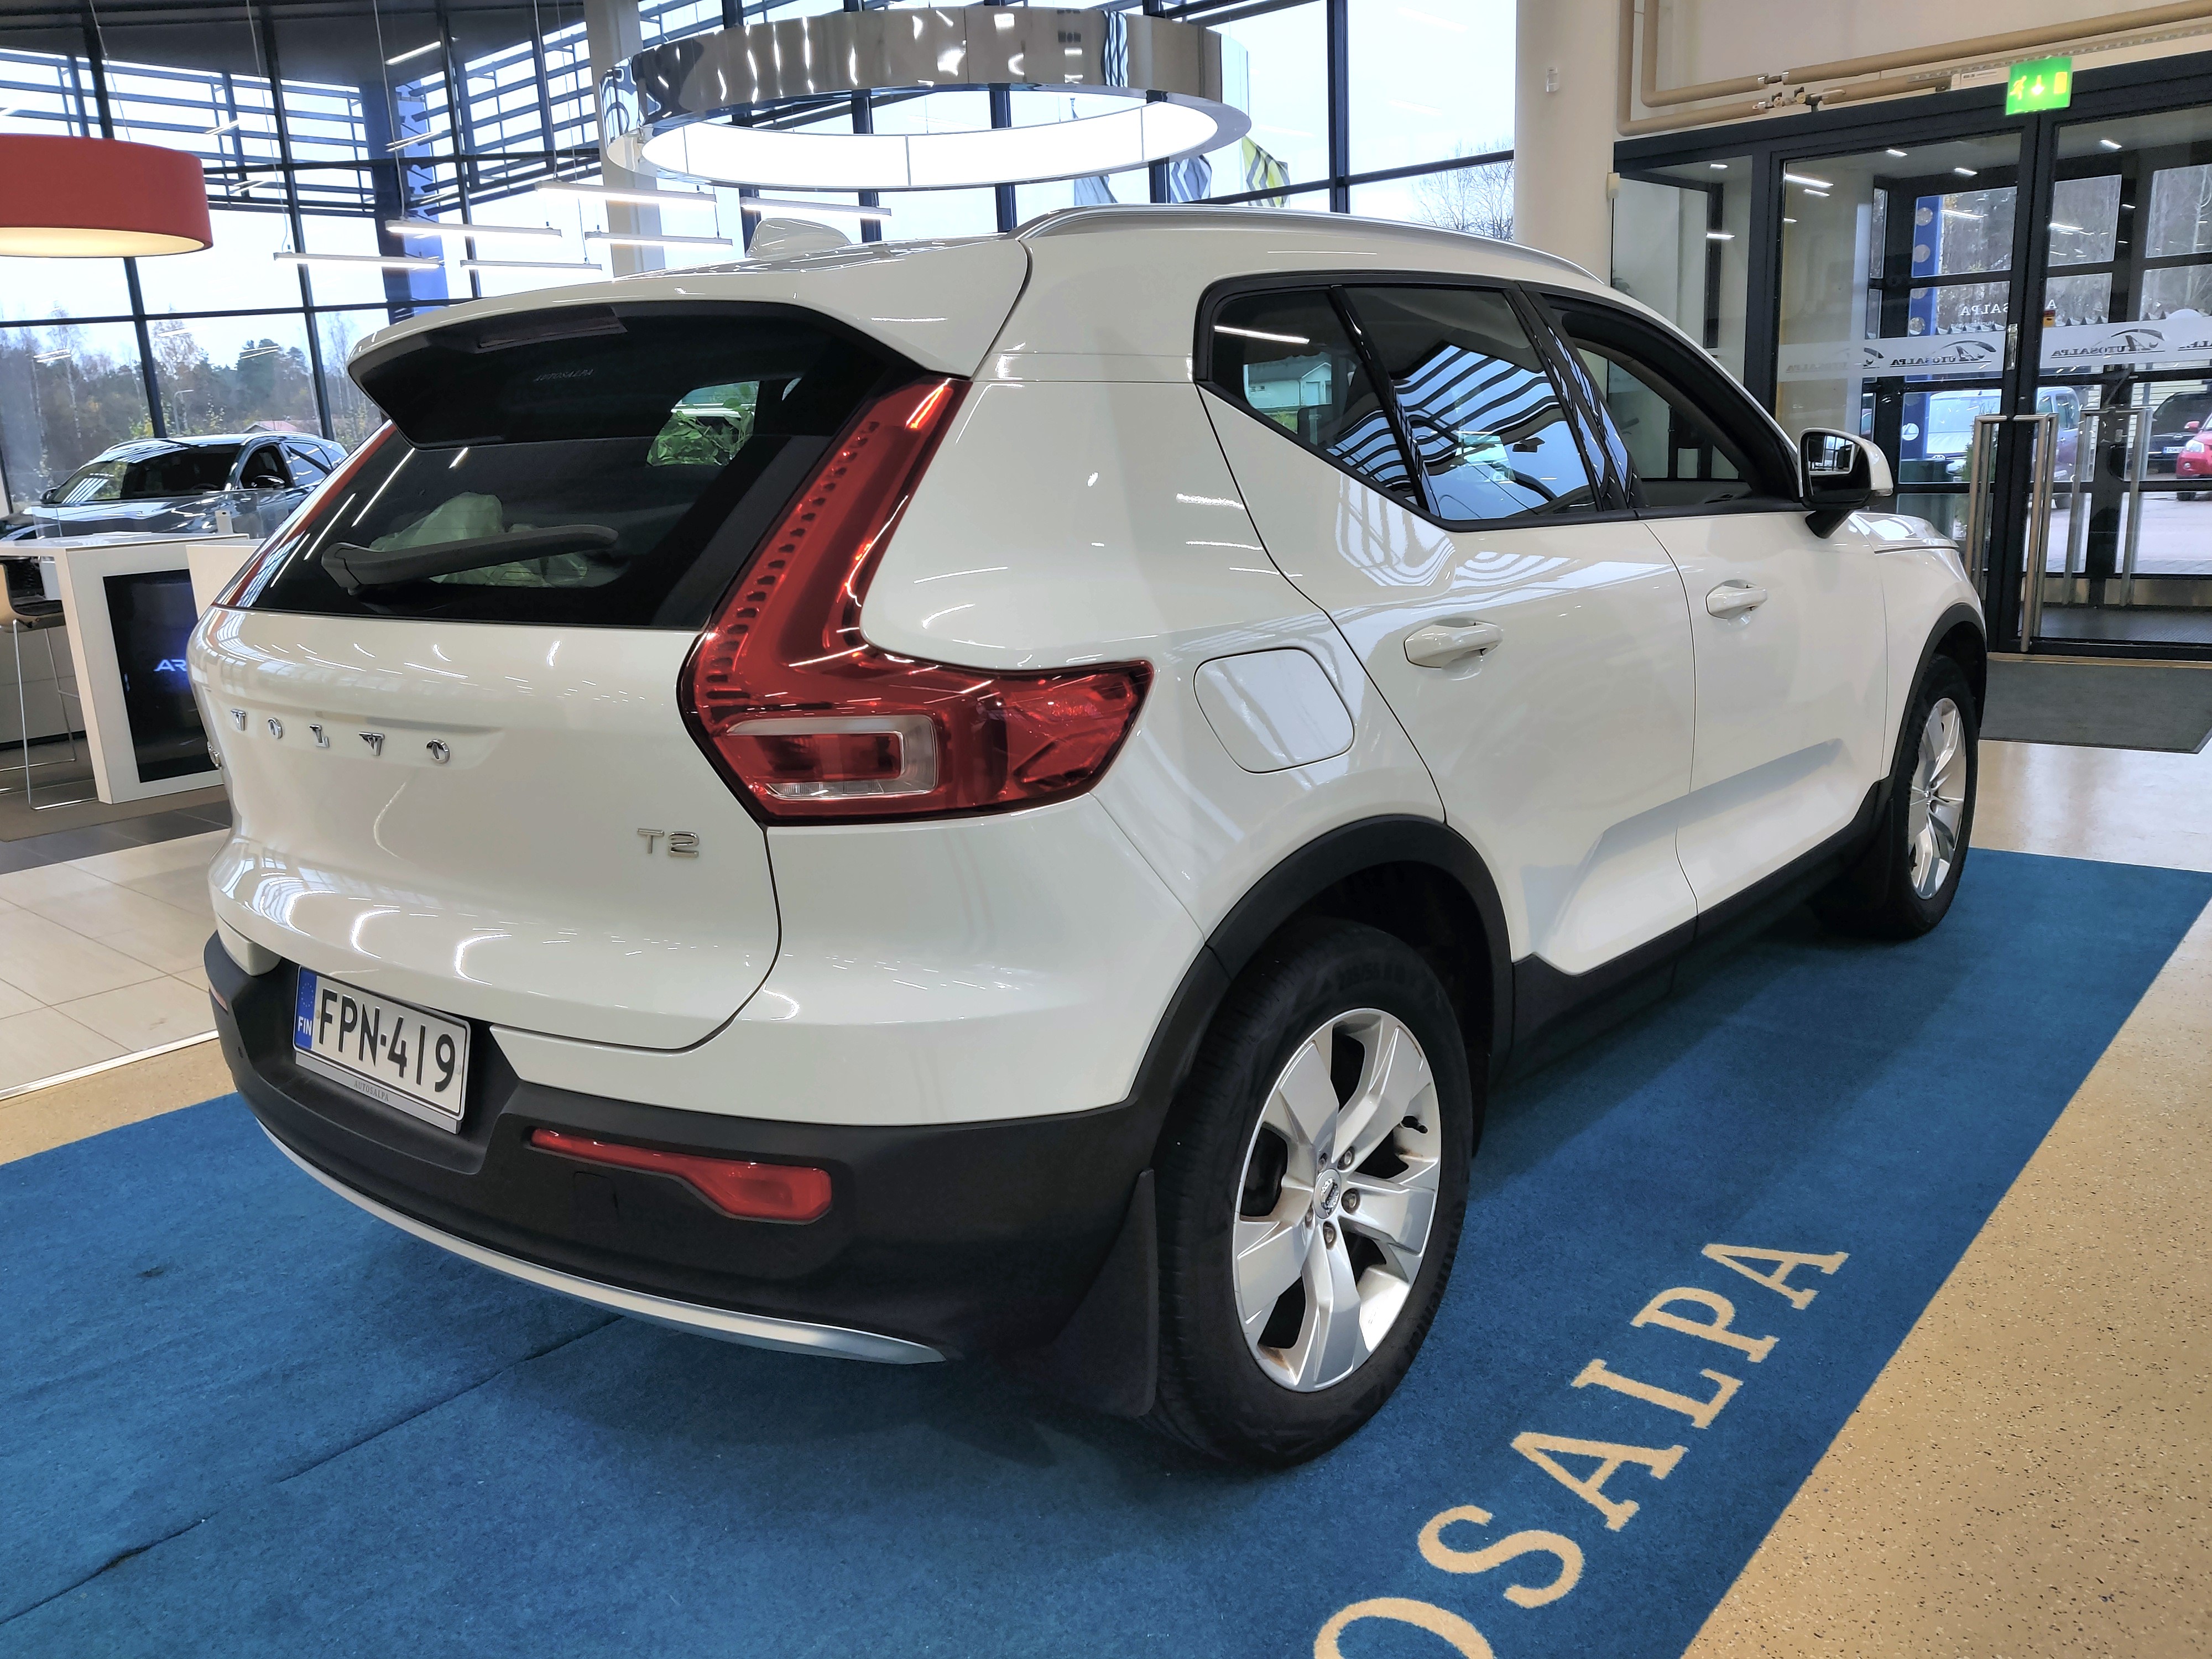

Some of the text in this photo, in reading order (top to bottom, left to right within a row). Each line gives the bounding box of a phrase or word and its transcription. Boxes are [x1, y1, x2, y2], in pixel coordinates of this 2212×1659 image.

[231, 708, 451, 764] VOLVO
[637, 828, 700, 858] T2
[298, 1016, 312, 1036] FIN
[319, 988, 456, 1093] FPN-419
[353, 1080, 389, 1102] AUTOSALPA
